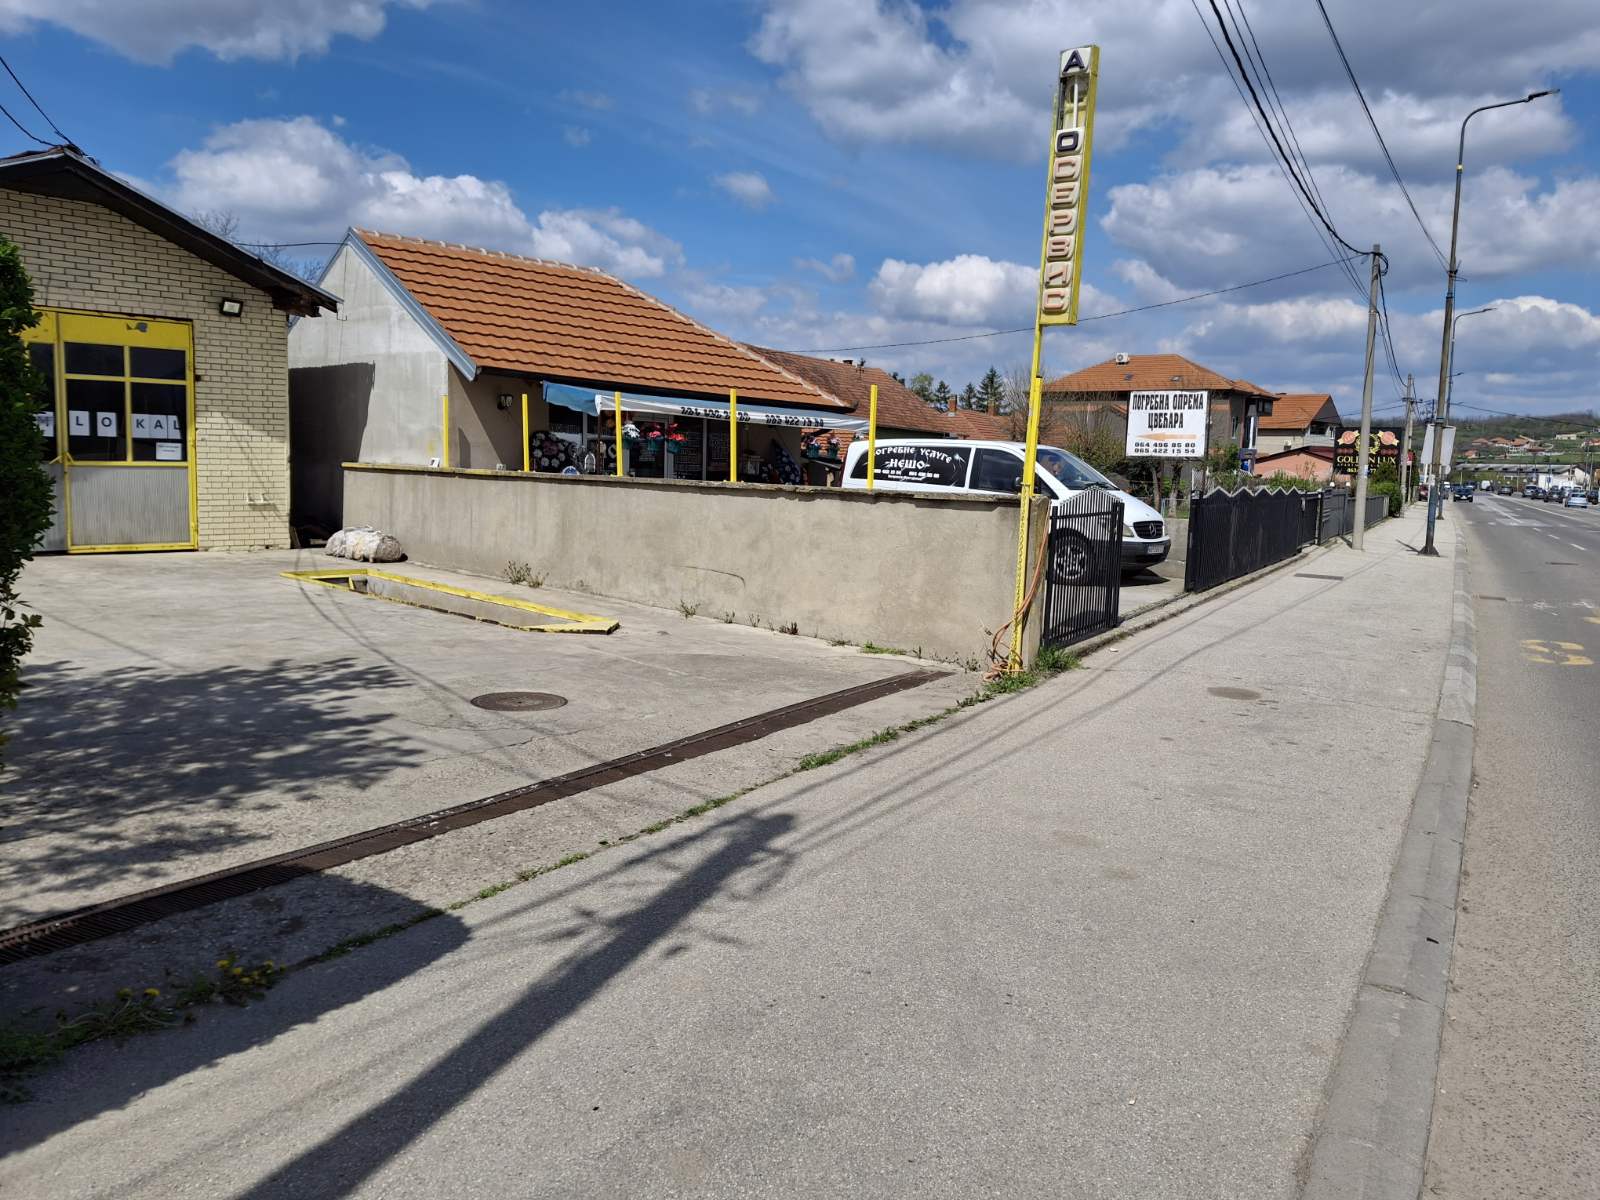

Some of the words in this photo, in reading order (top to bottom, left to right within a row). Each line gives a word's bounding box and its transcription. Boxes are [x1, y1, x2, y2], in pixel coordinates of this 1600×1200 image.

[1132, 394, 1169, 410] ПОГРЕБНА
[1173, 393, 1203, 410] ОПРЕМА
[1148, 412, 1183, 431] ЦВЕЋАРА
[874, 447, 916, 456] ОГРЕБНЕ
[890, 458, 925, 469] НЕШО
[1337, 455, 1375, 463] GOLN
